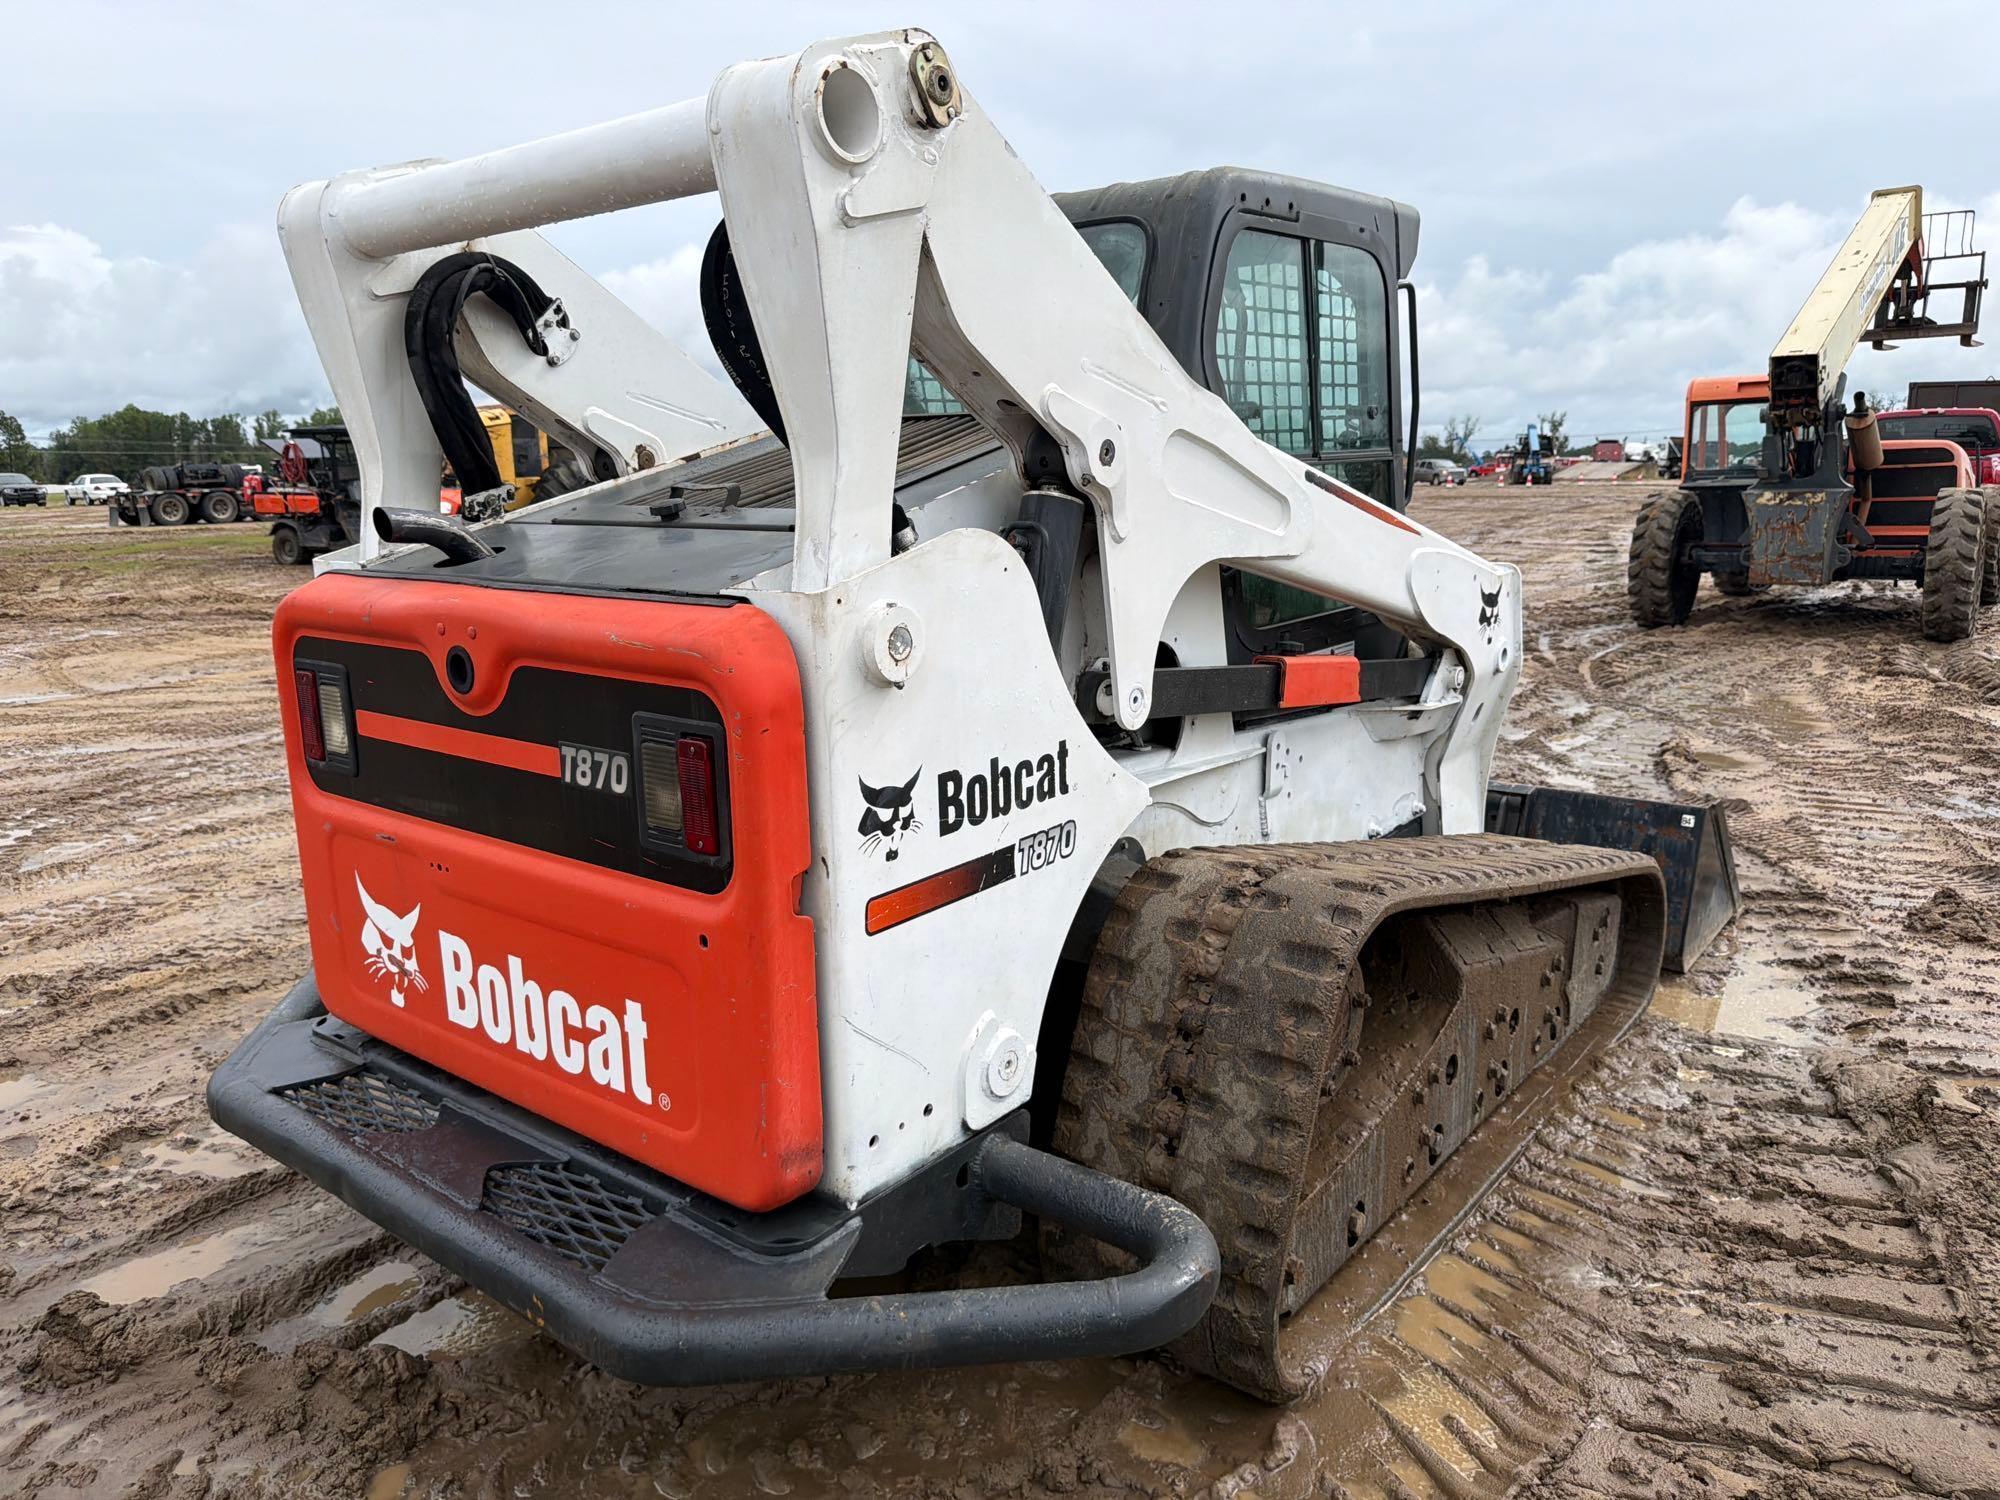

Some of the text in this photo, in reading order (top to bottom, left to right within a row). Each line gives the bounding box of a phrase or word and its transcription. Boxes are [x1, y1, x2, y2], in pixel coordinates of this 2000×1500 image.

[561, 744, 628, 794] T870
[937, 739, 1069, 837] Bobcat
[1018, 820, 1077, 876] T870
[438, 929, 652, 1105] Bobcat
